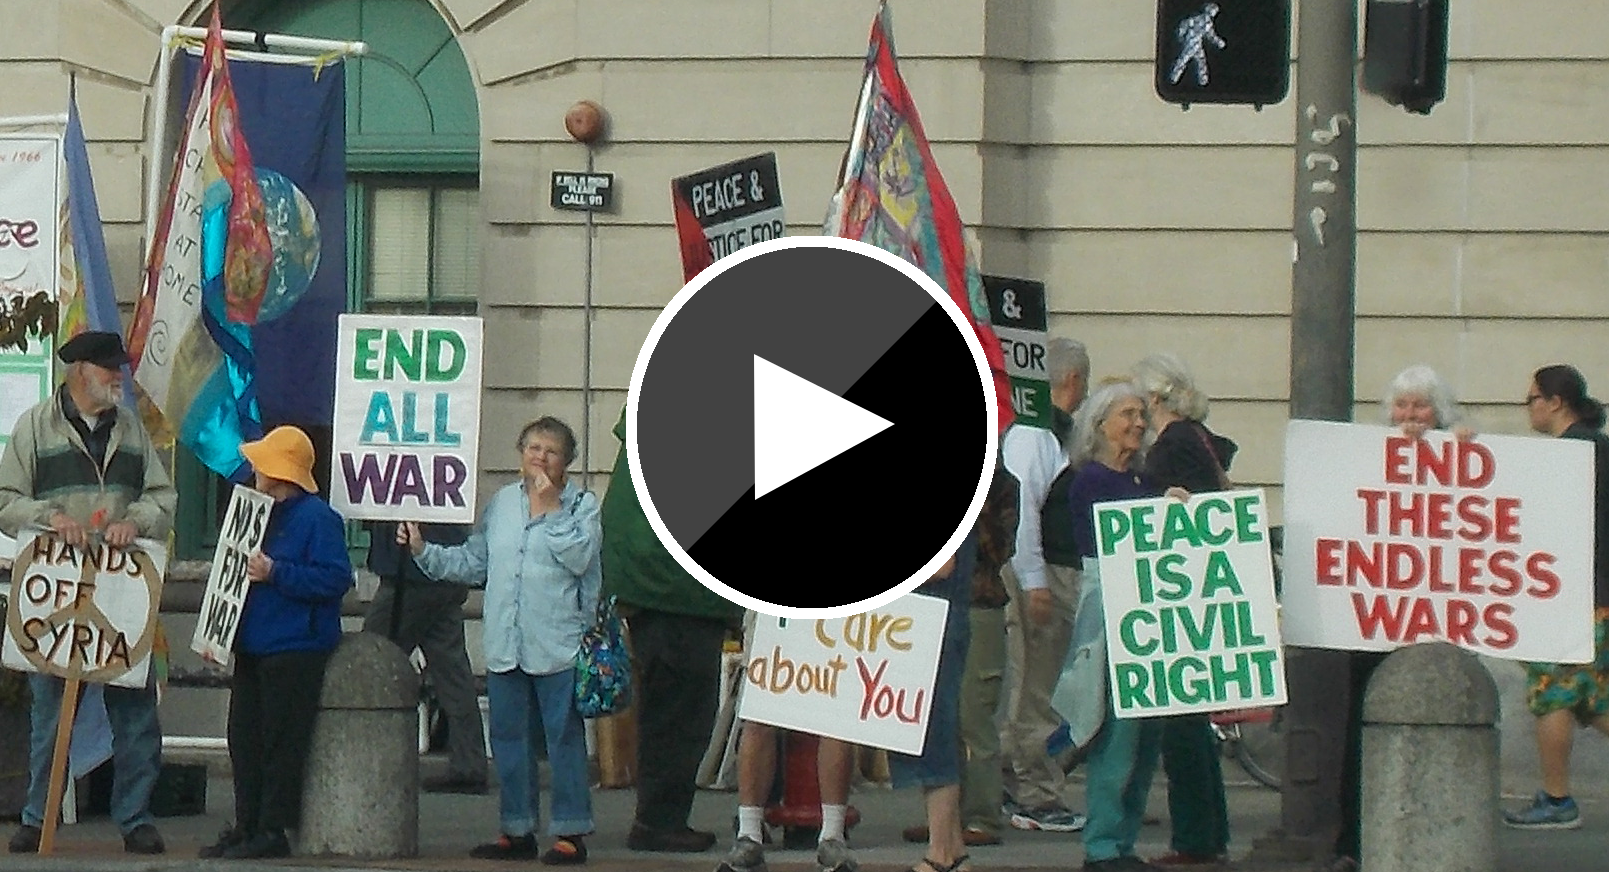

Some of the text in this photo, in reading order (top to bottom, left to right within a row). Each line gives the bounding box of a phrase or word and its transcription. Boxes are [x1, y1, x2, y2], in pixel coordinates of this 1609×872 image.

[561, 193, 585, 205] CALL
[692, 169, 765, 218] PEACE &
[174, 234, 198, 257] AT
[1002, 288, 1023, 320] &
[353, 328, 467, 382] END
[358, 390, 461, 445] ALL
[339, 452, 467, 508] WAR
[1385, 436, 1496, 489] END
[1097, 495, 1264, 556] PEACE
[1356, 489, 1523, 544] THESE
[32, 534, 146, 577] HANDS
[217, 545, 250, 600] FOR
[1135, 550, 1244, 604] IS A
[1315, 537, 1563, 599] ENDLESS
[25, 574, 96, 610] OFF
[19, 617, 131, 669] SYRIA
[203, 592, 238, 648] WAR
[1119, 601, 1266, 657] CIVIL
[1350, 592, 1519, 650] WARS
[747, 645, 926, 725] about You
[1115, 651, 1278, 709] RIGHT
